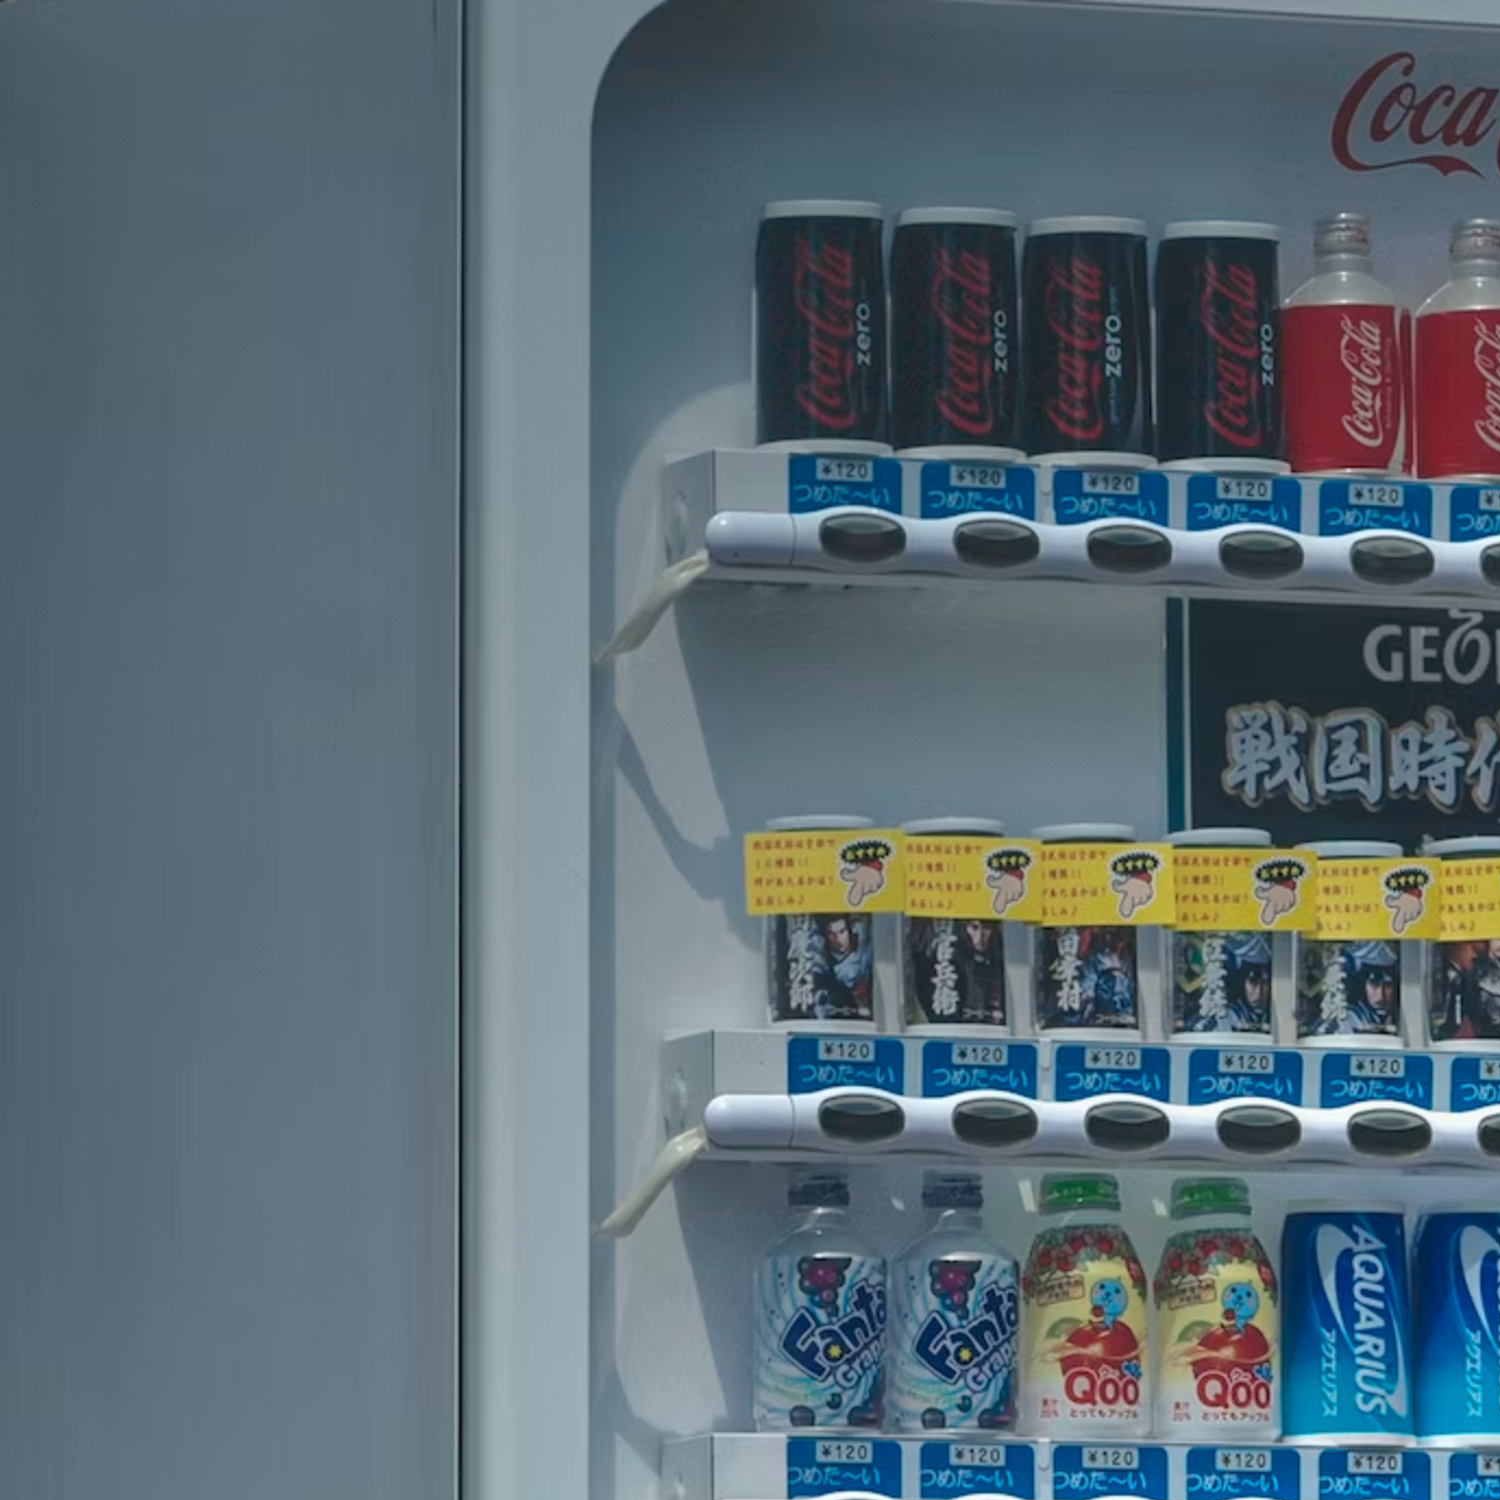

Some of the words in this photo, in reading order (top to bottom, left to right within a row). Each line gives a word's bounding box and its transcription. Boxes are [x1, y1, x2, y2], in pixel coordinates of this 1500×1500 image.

[856, 303, 870, 367] zero
[994, 310, 1008, 373] zero
[1105, 314, 1122, 379] zero
[1260, 323, 1275, 387] zero
[822, 459, 869, 478] ¥120
[956, 465, 1003, 484] ¥120
[1090, 471, 1136, 490] ¥120
[1222, 477, 1268, 496] ¥120
[1354, 483, 1399, 502] ¥120
[824, 1042, 871, 1059] ¥120
[958, 1046, 1005, 1063] ¥120
[1091, 1050, 1138, 1066] ¥120
[1223, 1054, 1270, 1070] ¥120
[1355, 1057, 1401, 1074] ¥120
[1351, 1224, 1388, 1415] AQUARIUS
[1320, 1327, 1338, 1417] アクエリアス
[1465, 1327, 1484, 1418] アクエリアス
[1064, 1367, 1141, 1408] Qoo
[1196, 1370, 1272, 1410] Qoo
[821, 1444, 868, 1461] ¥120
[955, 1447, 1003, 1463] ¥120
[1089, 1449, 1136, 1466] ¥120
[1222, 1452, 1268, 1468] ¥120
[1353, 1454, 1399, 1471] ¥120
